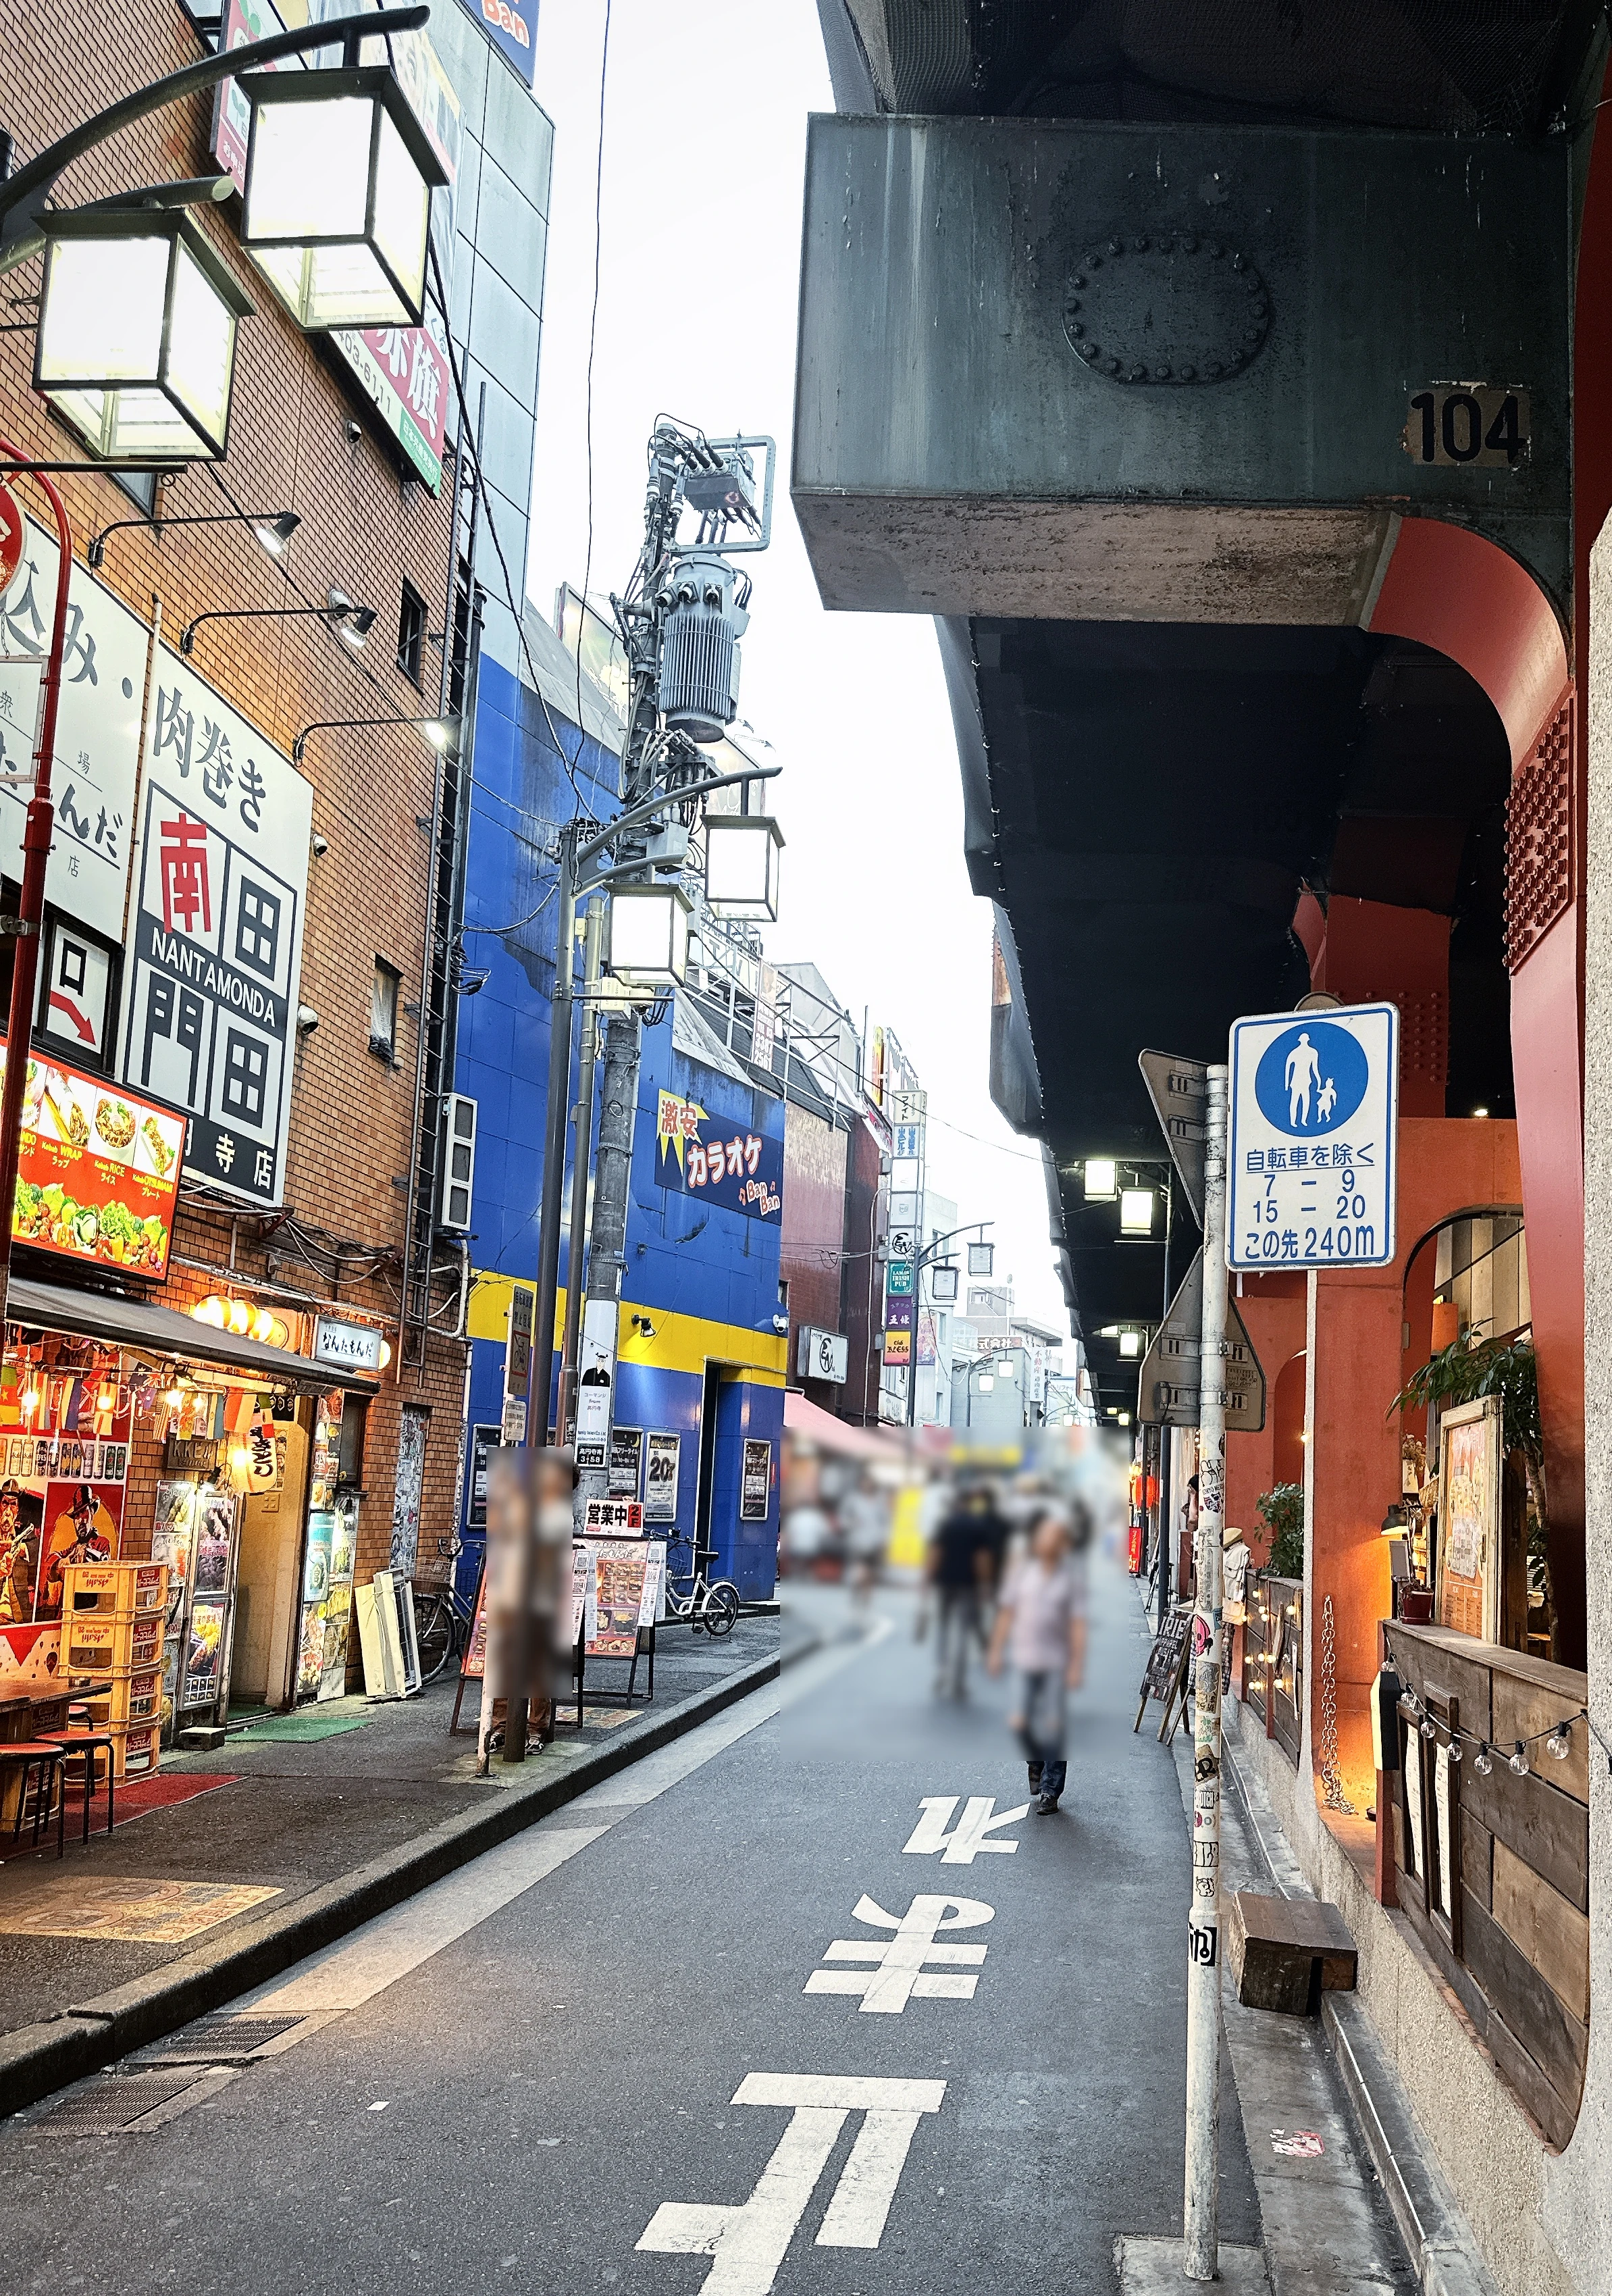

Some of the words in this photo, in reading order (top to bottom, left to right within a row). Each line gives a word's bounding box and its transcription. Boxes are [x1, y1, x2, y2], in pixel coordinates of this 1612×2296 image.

[1411, 392, 1528, 464] 104
[153, 684, 267, 834] 肉巻き
[151, 927, 276, 1028] NANTAMONDA
[661, 1096, 698, 1140] 激安
[52, 1155, 70, 1169] ラップ
[60, 1145, 83, 1161] WRAP
[686, 1133, 762, 1189] カラオケ
[1245, 1142, 1375, 1171] 自転車を除く
[101, 1173, 116, 1185] ライス
[109, 1163, 126, 1177] RICE
[141, 1186, 161, 1200] プレート
[746, 1179, 768, 1202] Ban
[1264, 1174, 1276, 1197] 7
[1341, 1170, 1355, 1193] 9
[760, 1195, 781, 1216] Ban
[1253, 1200, 1278, 1224] 15
[1335, 1194, 1366, 1219] 20
[1245, 1223, 1375, 1260] この先240m
[323, 1331, 374, 1358] なんたもんだ
[587, 1503, 627, 1527] 営業中
[630, 1505, 640, 1527] 2F
[85, 1579, 109, 1588] Asahi
[81, 1633, 105, 1643] Asahi
[1158, 1615, 1187, 1640] IRIE
